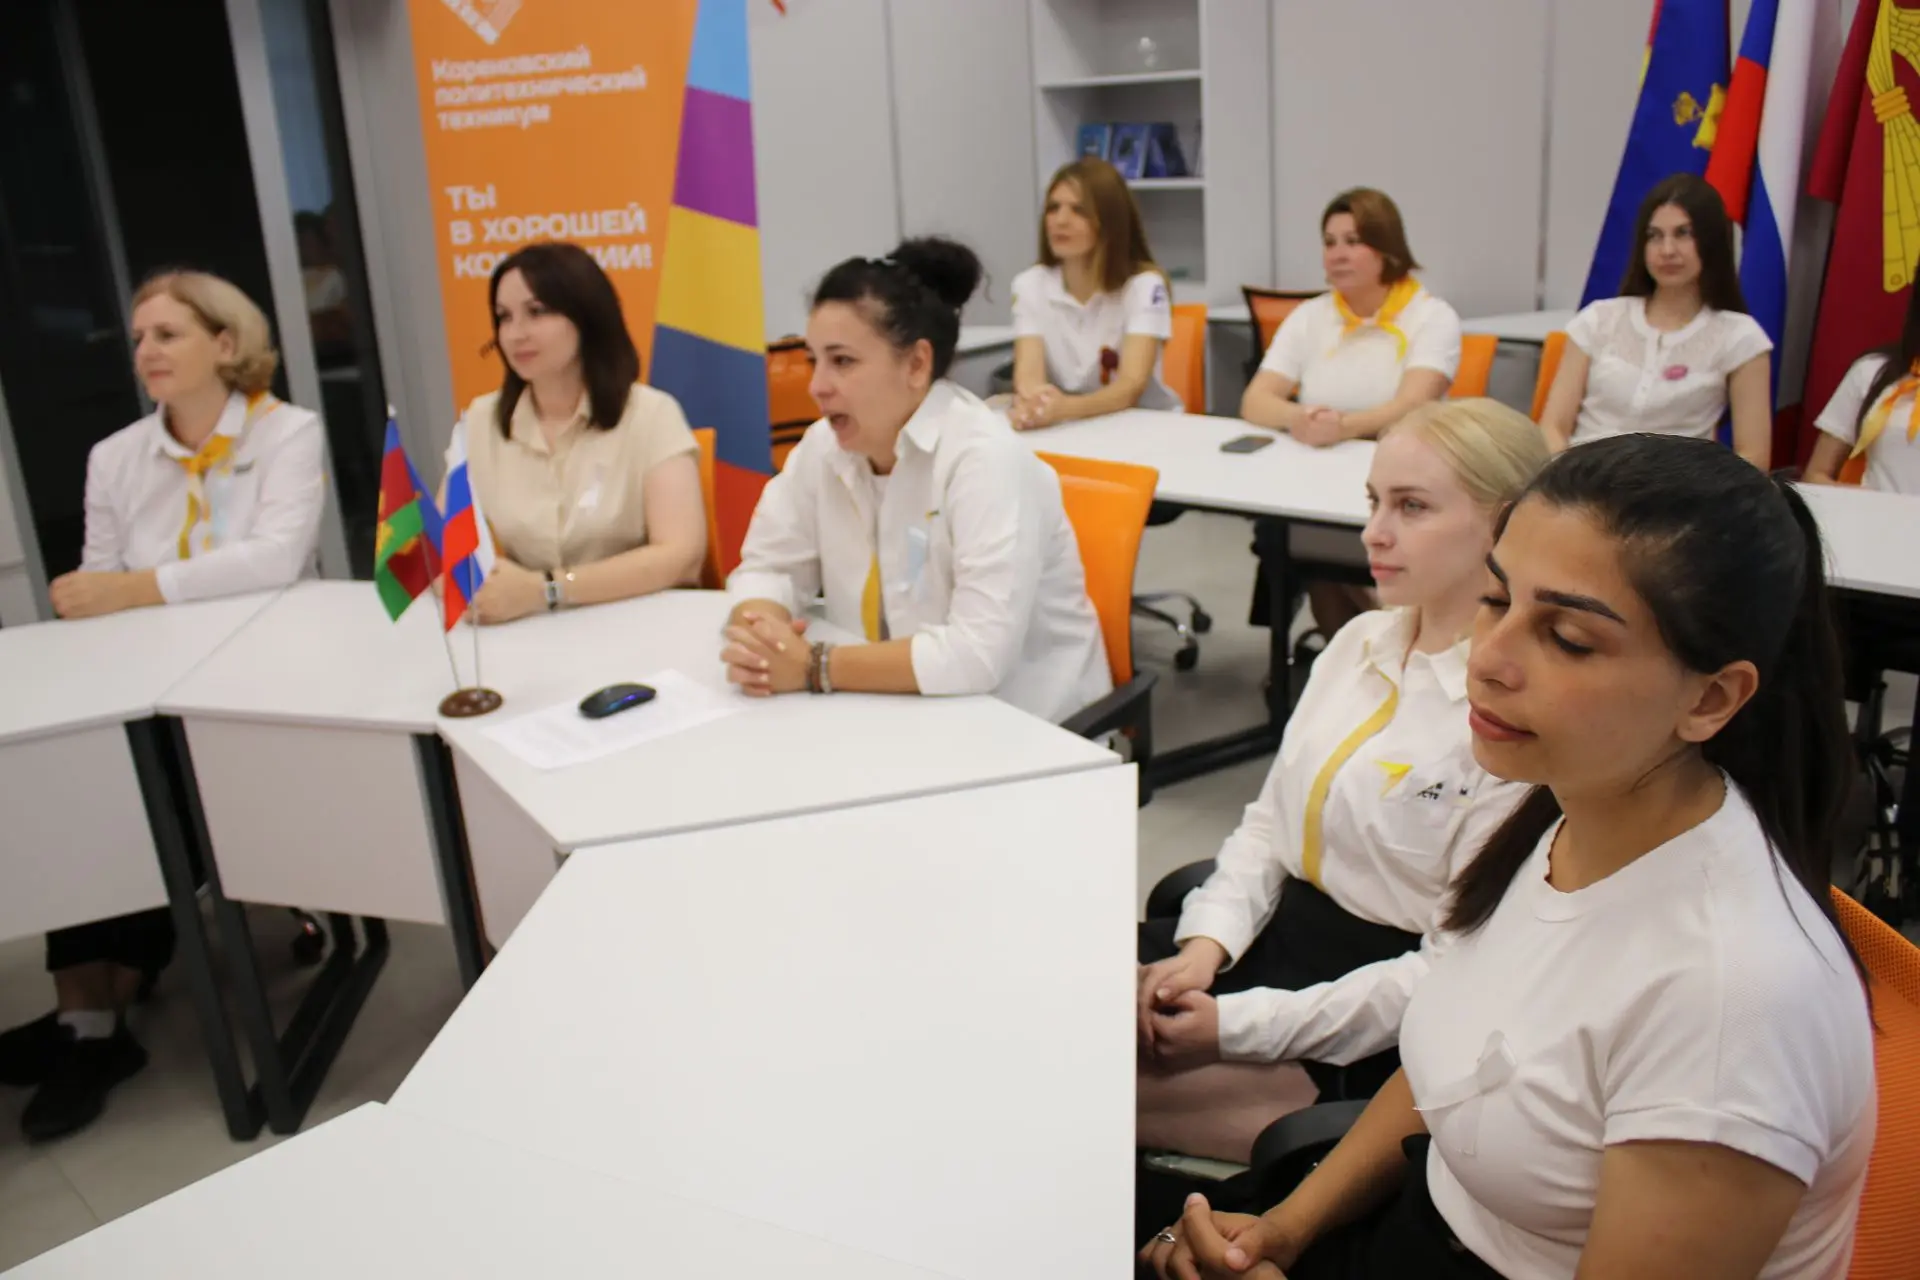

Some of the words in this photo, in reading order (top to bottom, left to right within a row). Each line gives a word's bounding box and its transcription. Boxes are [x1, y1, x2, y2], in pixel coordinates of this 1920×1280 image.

[435, 64, 647, 106] политехнический
[437, 104, 550, 129] техникум
[445, 183, 497, 212] ТЫ
[450, 220, 474, 245] В
[481, 202, 647, 244] ХОРОШЕЙ
